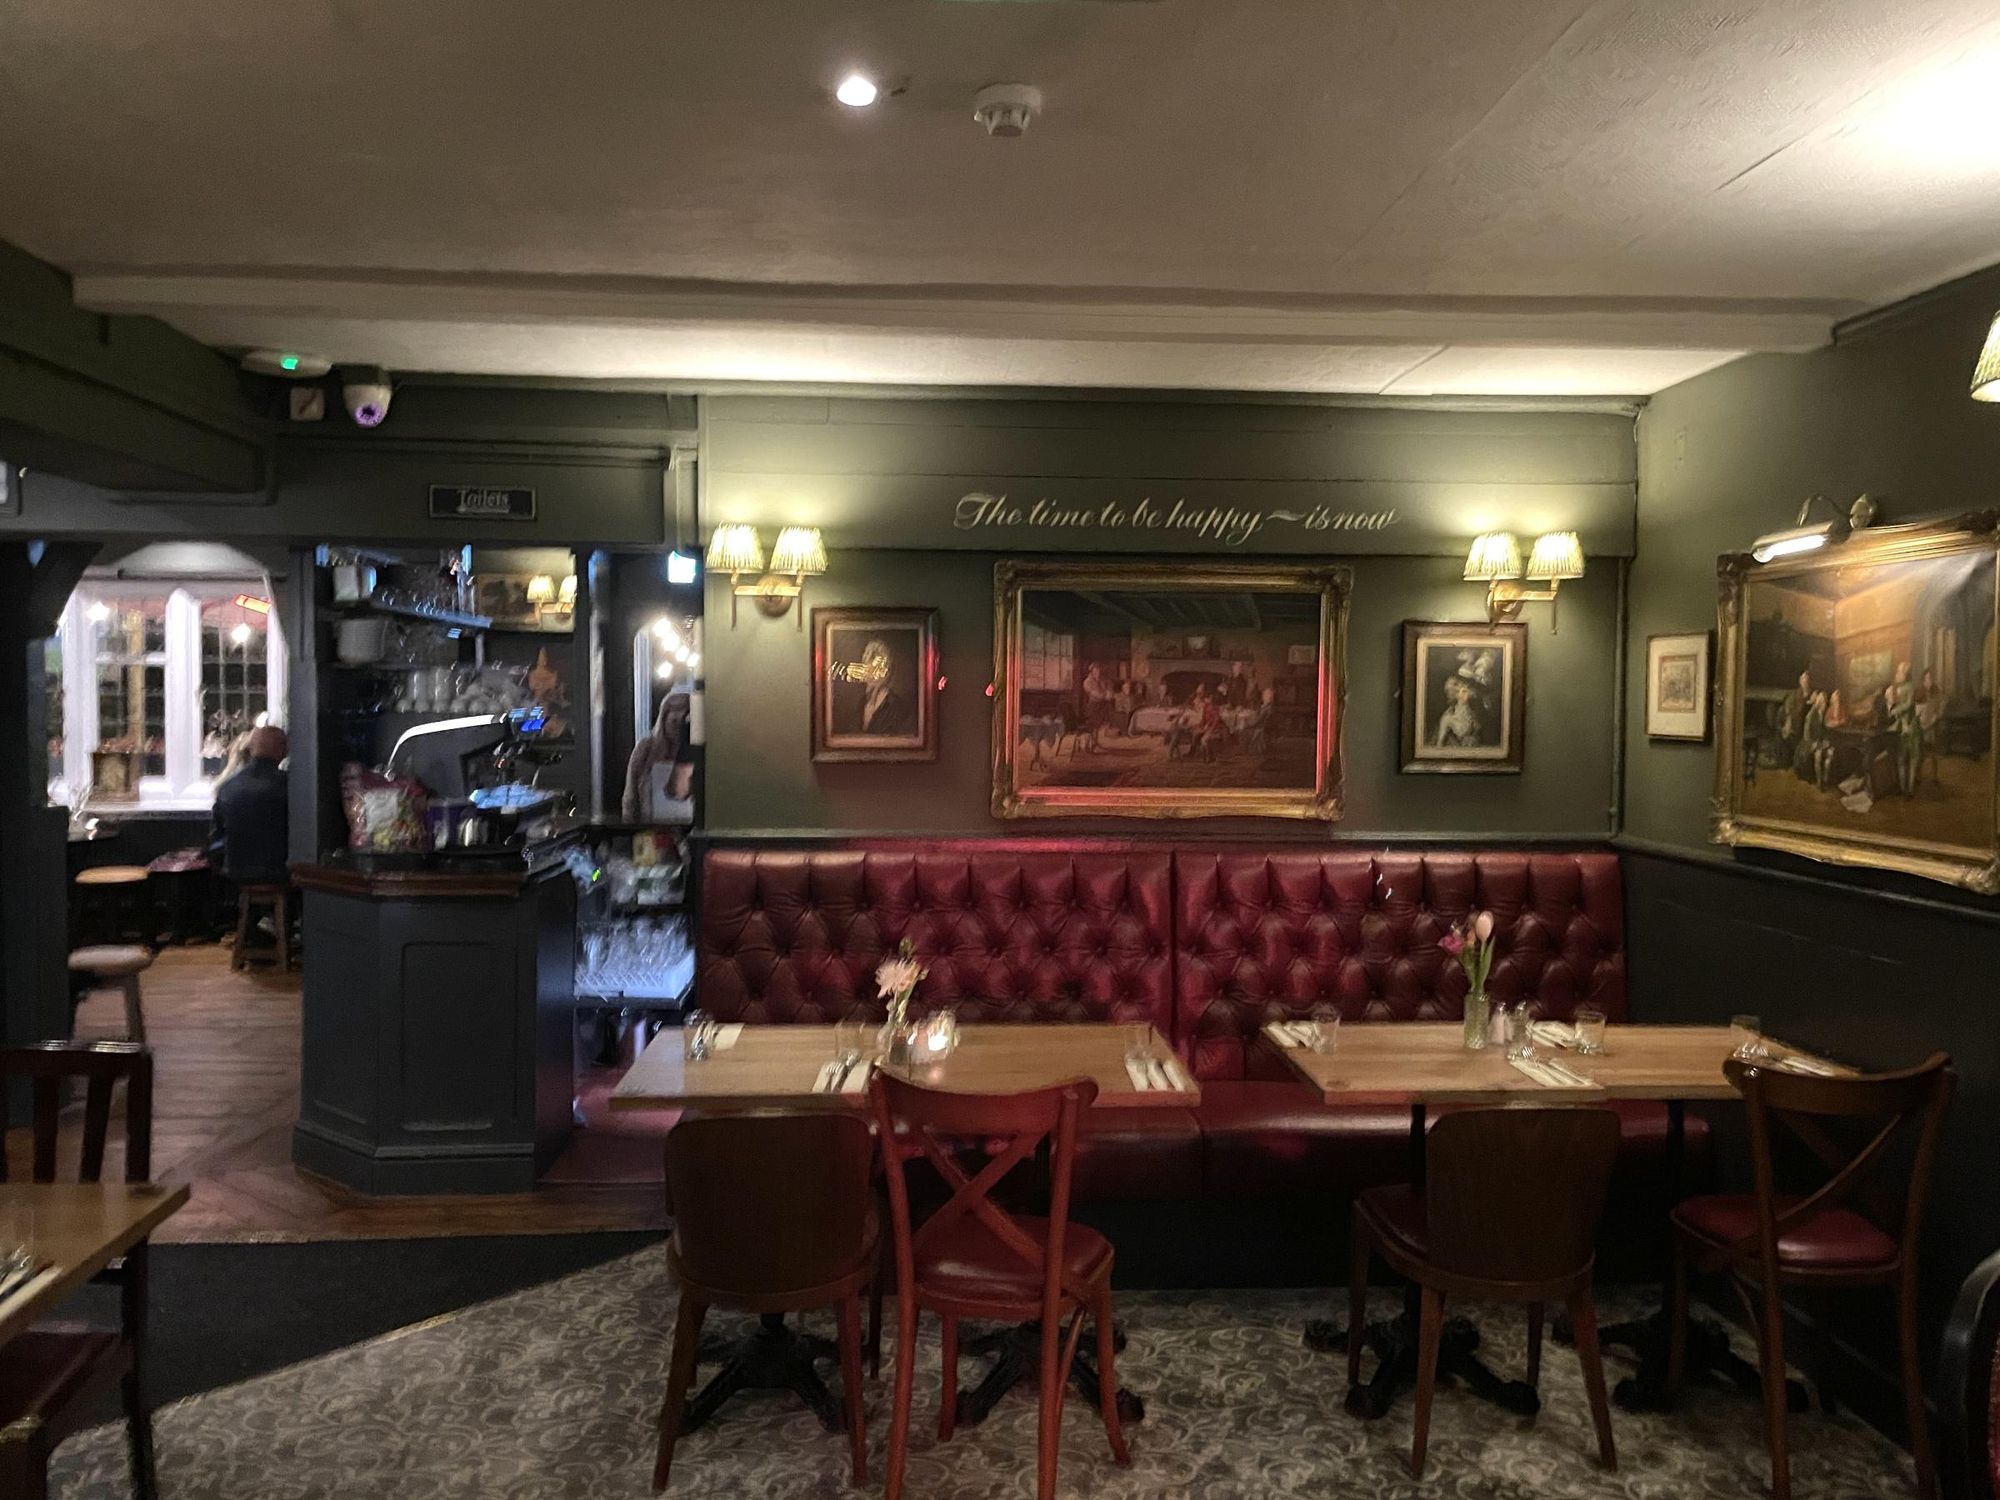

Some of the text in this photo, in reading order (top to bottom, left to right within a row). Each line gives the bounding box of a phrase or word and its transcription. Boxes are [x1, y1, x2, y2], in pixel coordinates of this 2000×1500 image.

[953, 492, 1400, 546] The time to be happy is now
